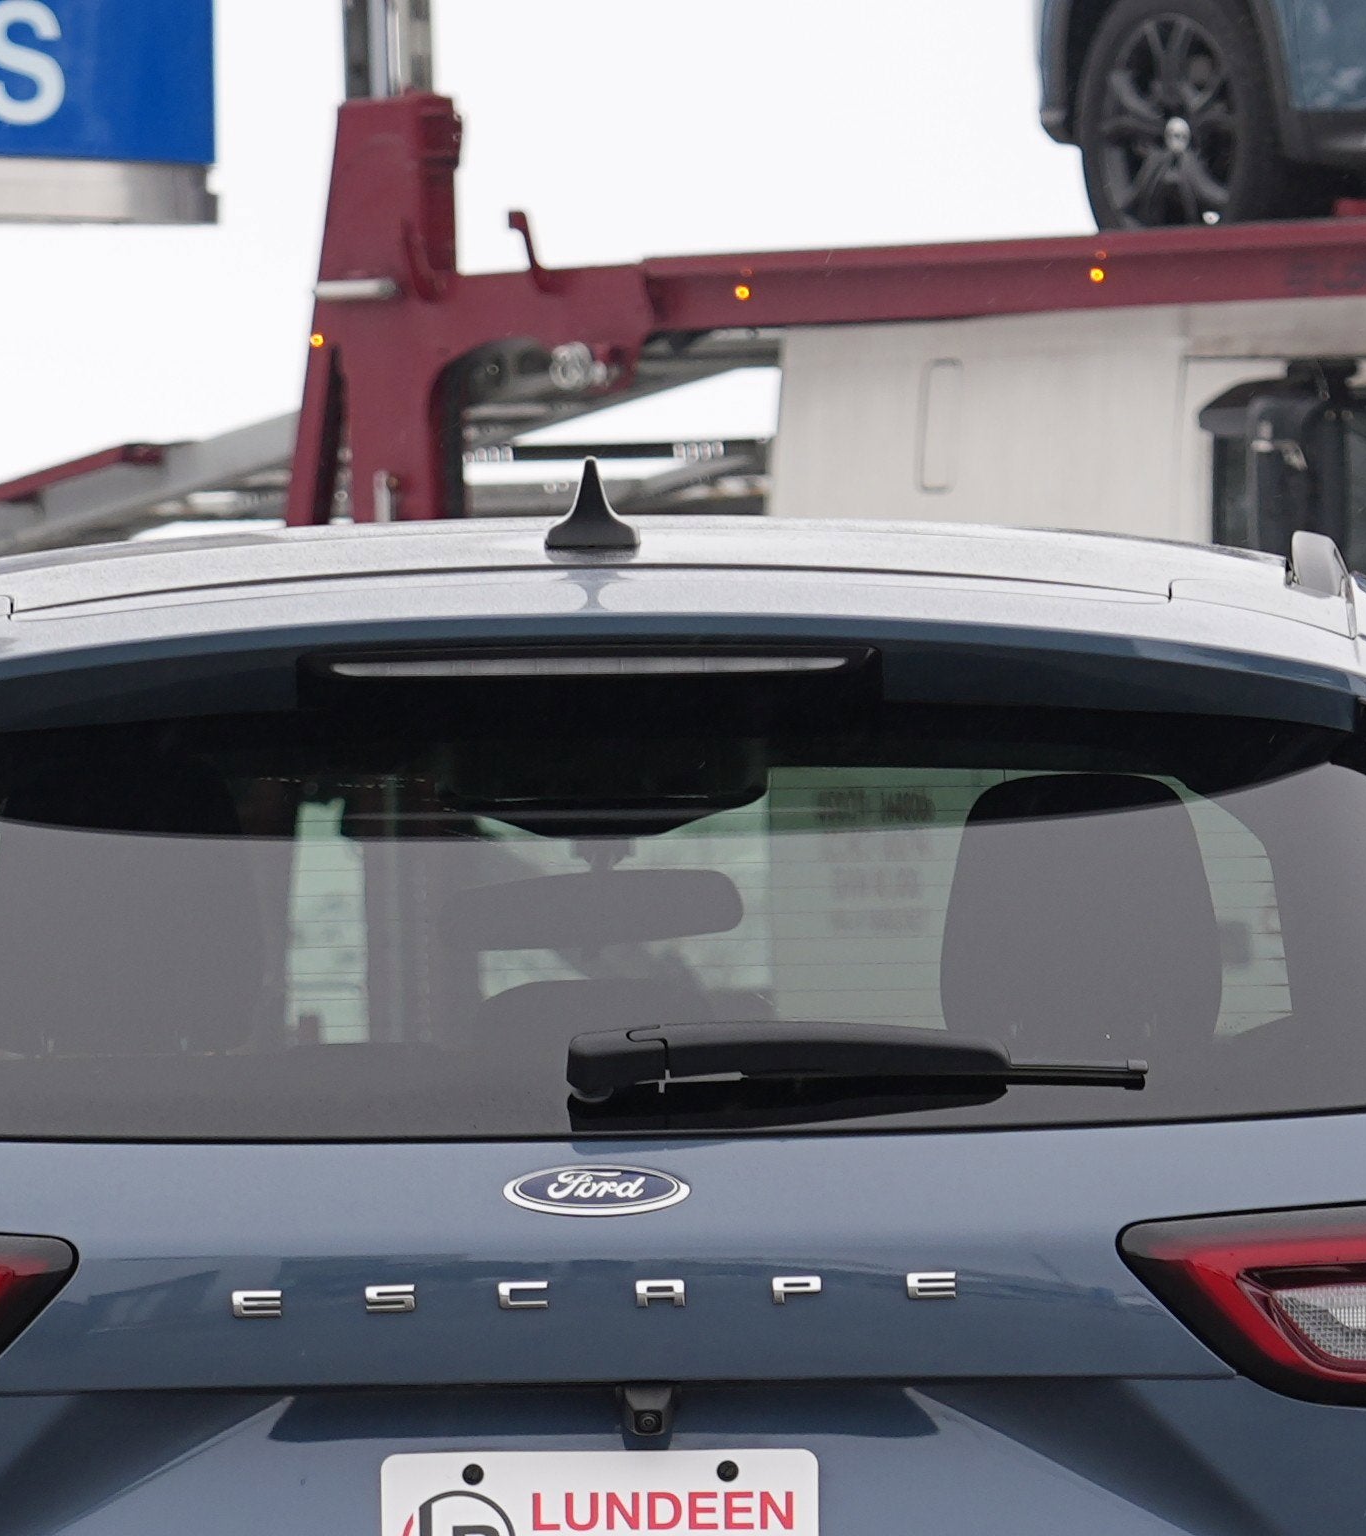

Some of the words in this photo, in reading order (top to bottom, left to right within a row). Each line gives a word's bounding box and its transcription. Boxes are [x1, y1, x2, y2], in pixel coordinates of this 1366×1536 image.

[548, 1170, 646, 1200] Ford
[231, 1269, 958, 1318] ESCAPE
[531, 1490, 795, 1532] LUNDEEN
